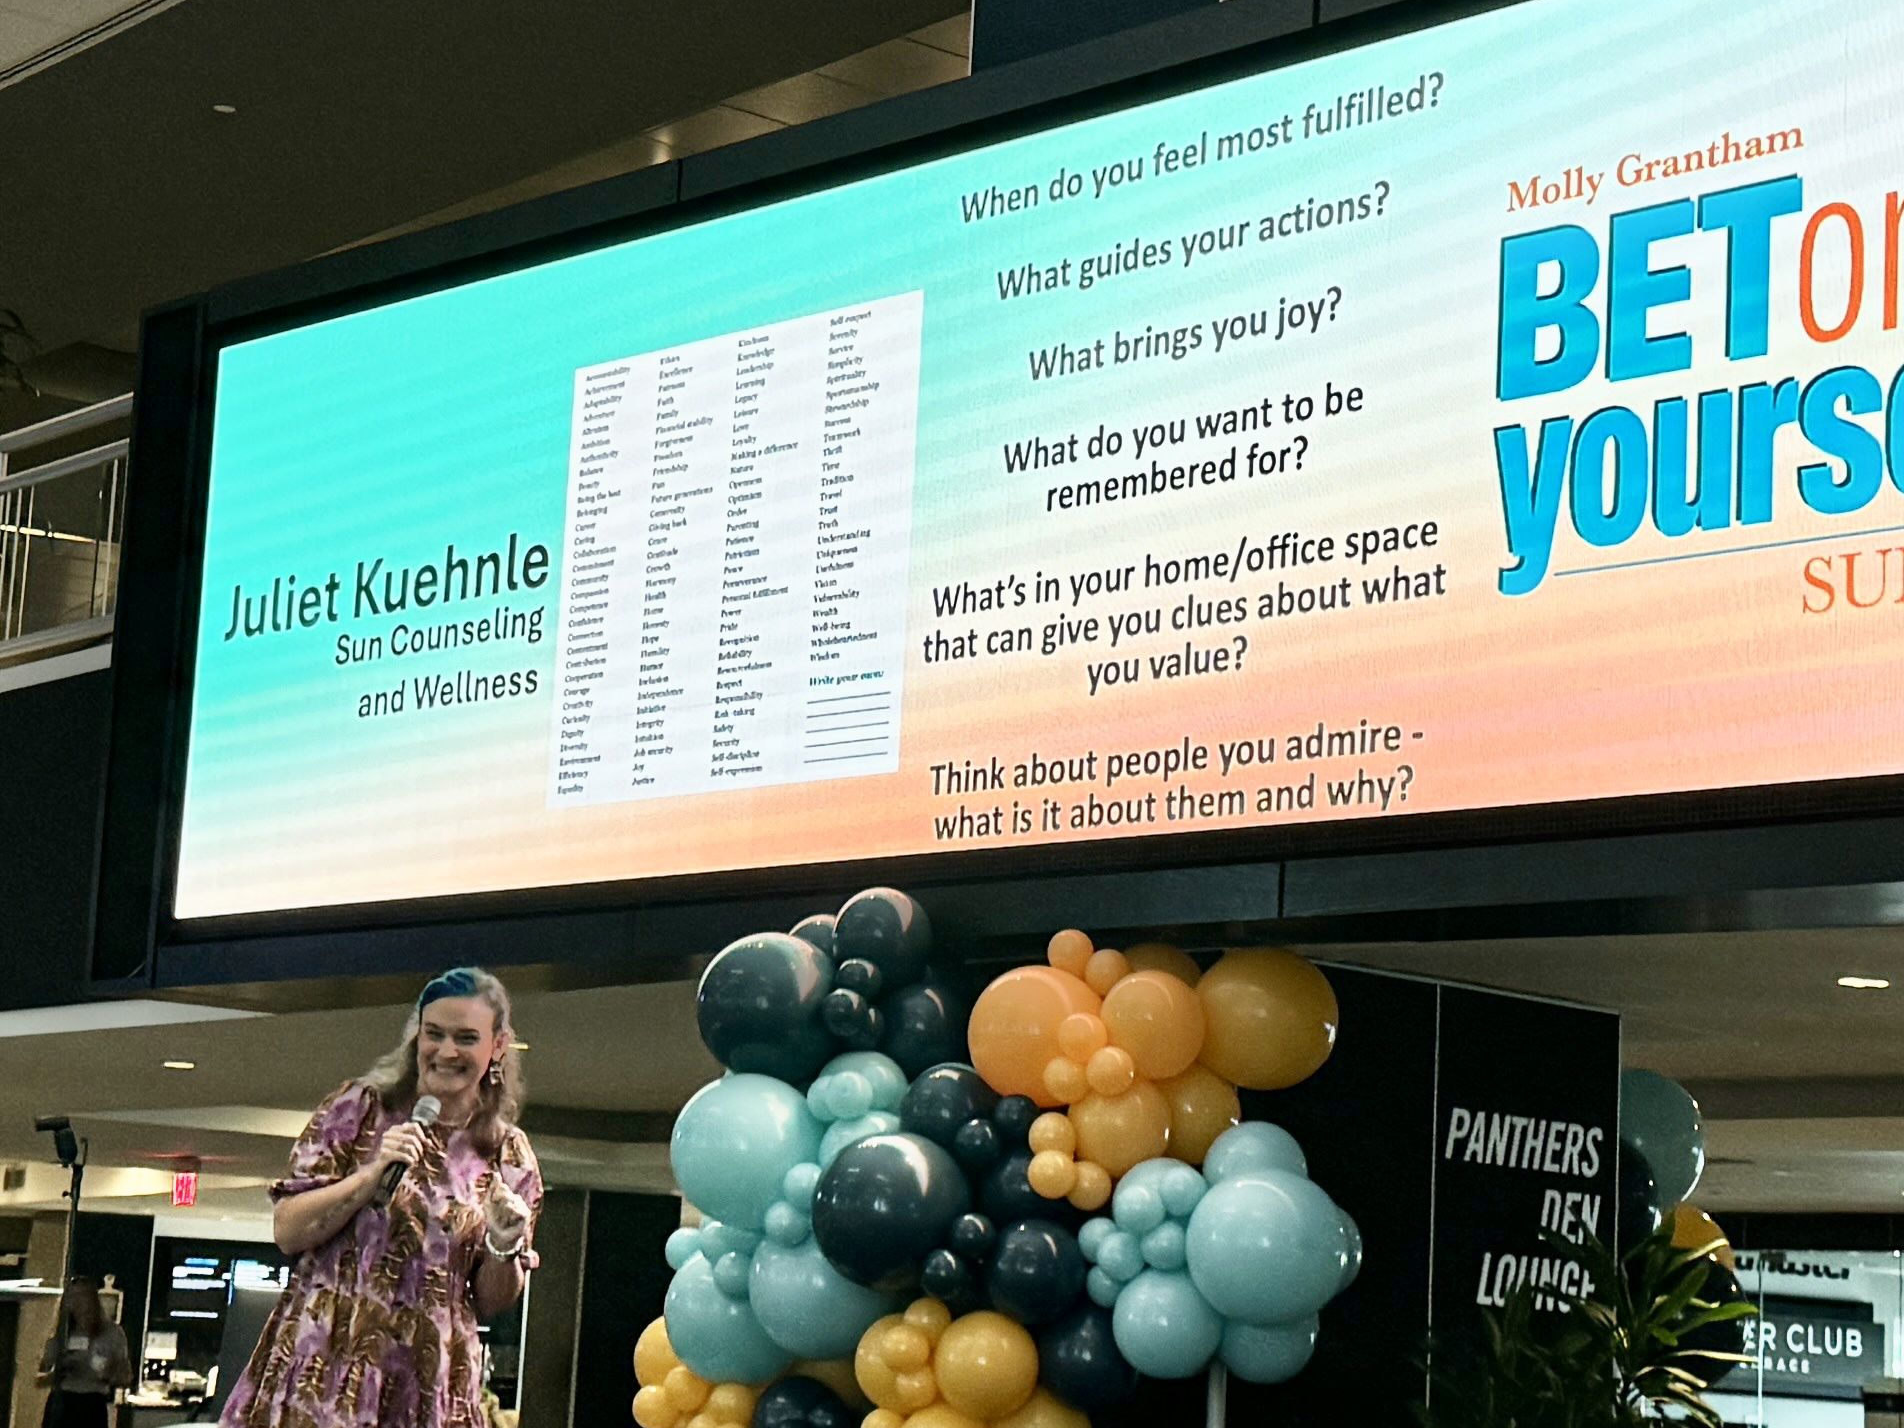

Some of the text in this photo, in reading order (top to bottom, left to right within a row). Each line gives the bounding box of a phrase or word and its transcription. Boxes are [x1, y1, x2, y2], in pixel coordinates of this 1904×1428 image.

[960, 70, 1444, 224] When do you feel most fulfilled?
[1506, 126, 1804, 212] Molly Grantham
[996, 179, 1391, 301] What guides your actions?
[1496, 173, 1803, 401] BET
[1028, 284, 1343, 382] What brings you joy?
[1002, 380, 1364, 475] What do you want to be
[1045, 433, 1309, 513] remembered for?
[223, 531, 550, 643] Juliet Kuehnle
[931, 520, 1439, 619] What's in your home/office space
[334, 604, 546, 666] Sun Counseling
[921, 562, 1448, 665] that can give you clues about what
[357, 668, 539, 719] and Wellness
[1086, 634, 1249, 697] you value?
[928, 755, 1006, 797] Think
[1012, 749, 1099, 789] about
[1105, 734, 1209, 787] people
[1217, 736, 1276, 776] you
[1285, 717, 1402, 762] admire
[933, 763, 1414, 841] what is it about them and why?
[1445, 1107, 1604, 1178] PANTHERS
[1538, 1189, 1601, 1245] DEN
[1786, 1323, 1864, 1358] CLUB
